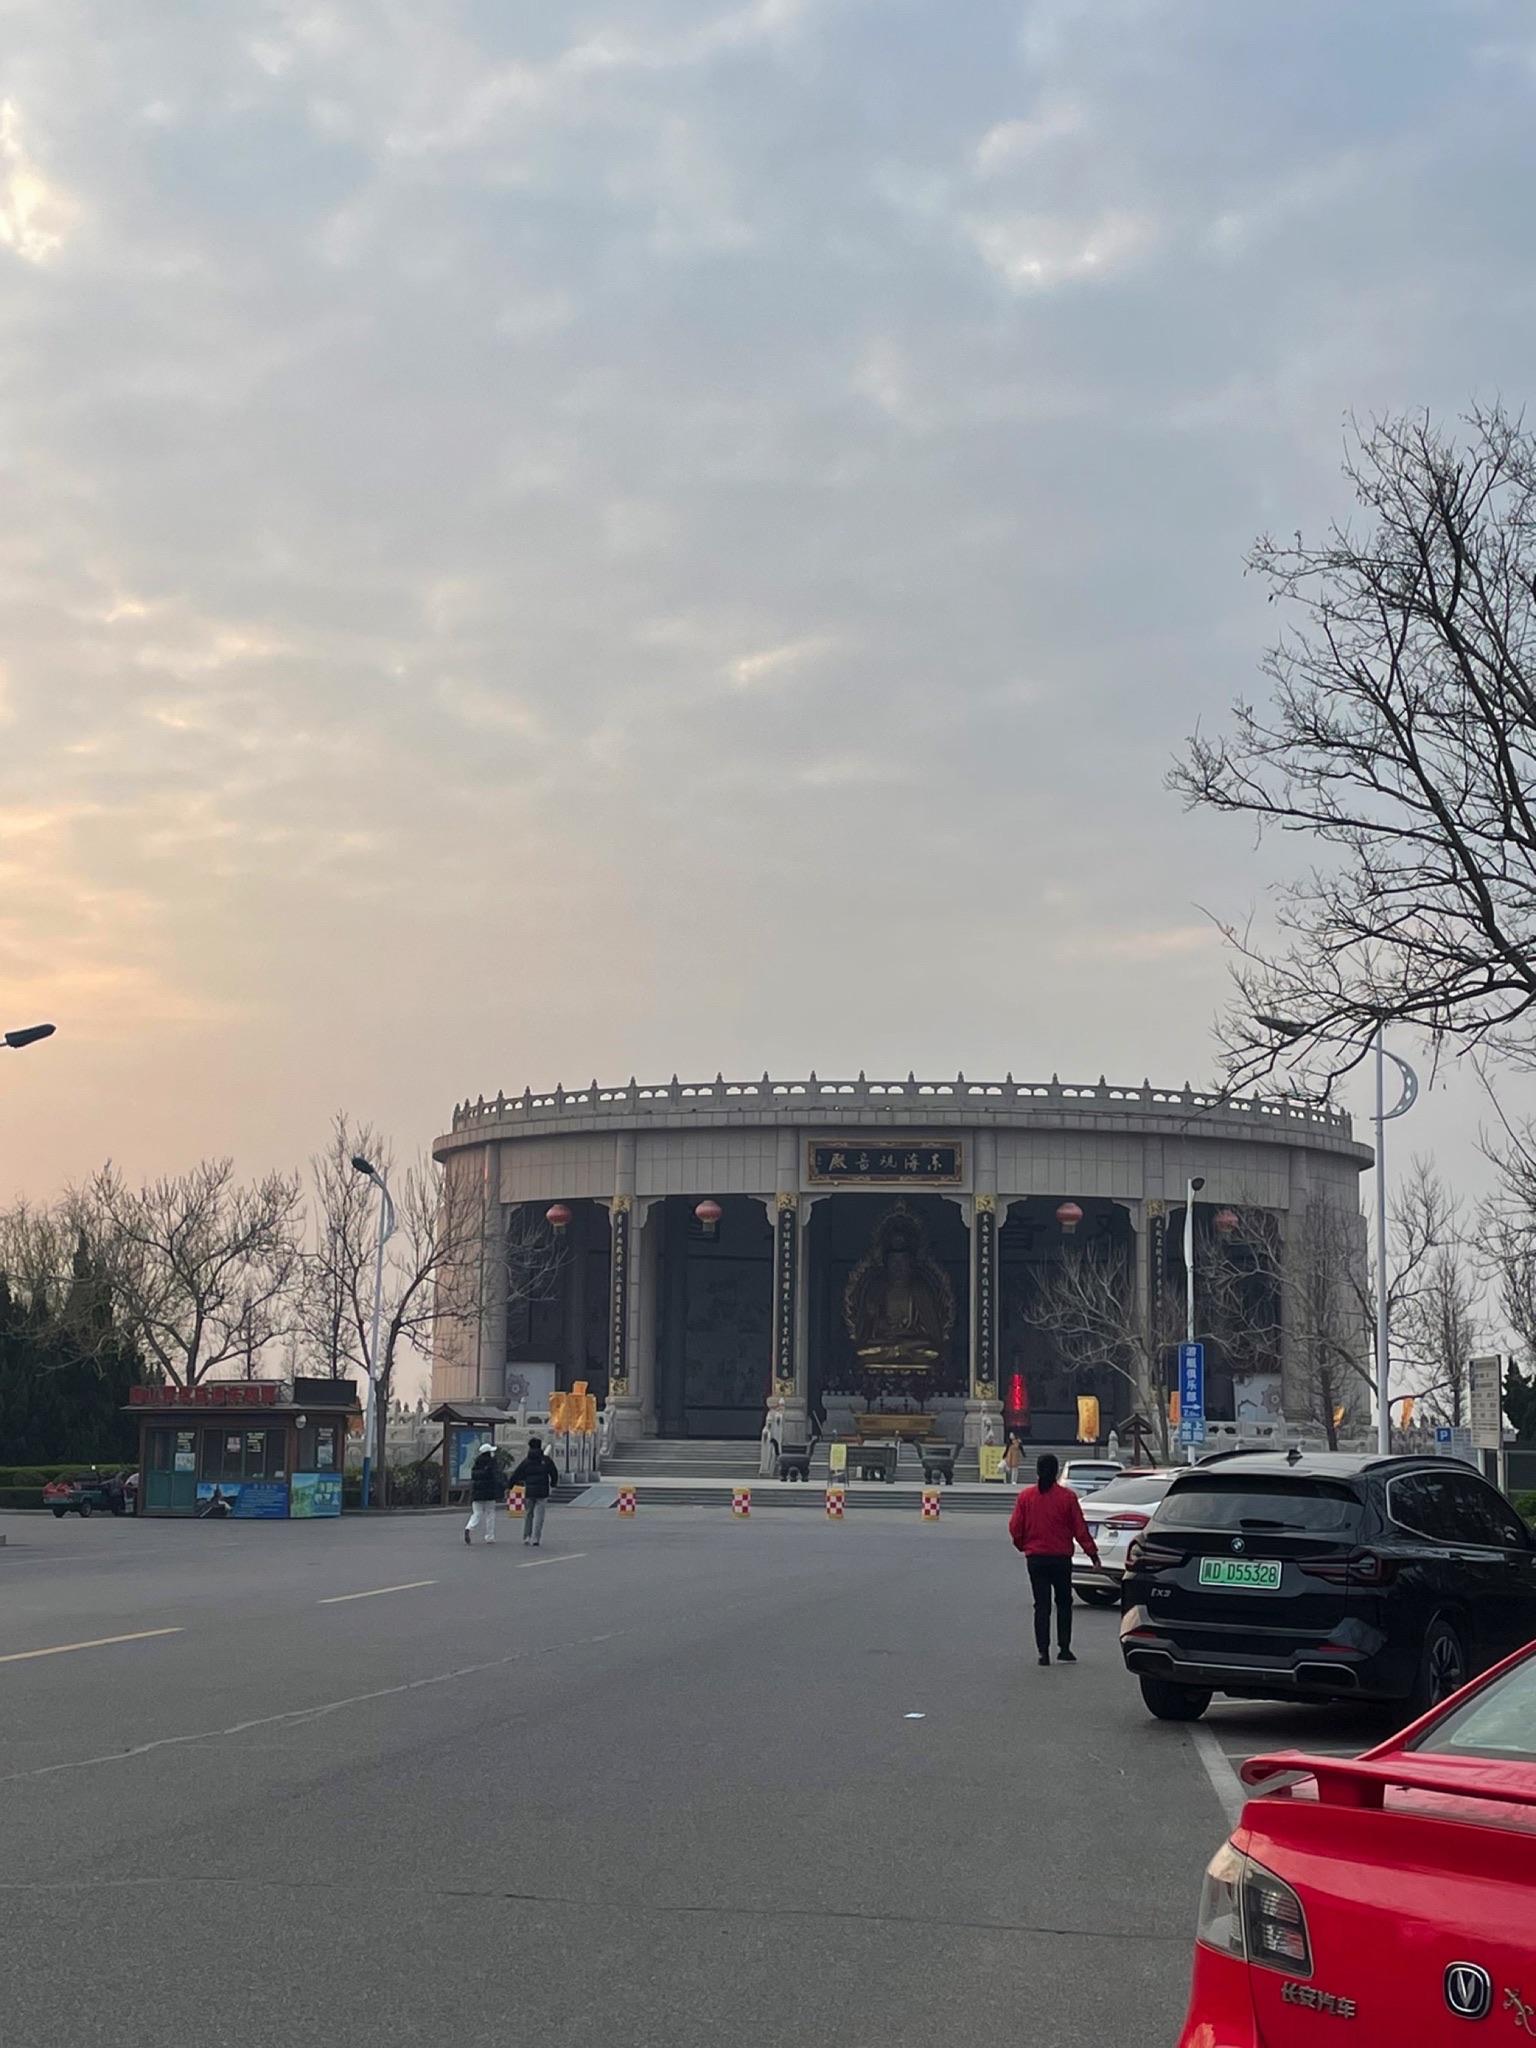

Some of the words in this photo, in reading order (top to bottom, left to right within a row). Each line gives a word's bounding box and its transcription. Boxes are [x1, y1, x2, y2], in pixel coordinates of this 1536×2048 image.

[1440, 1430, 1448, 1441] P
[1281, 1981, 1357, 2019] 长安汽车
